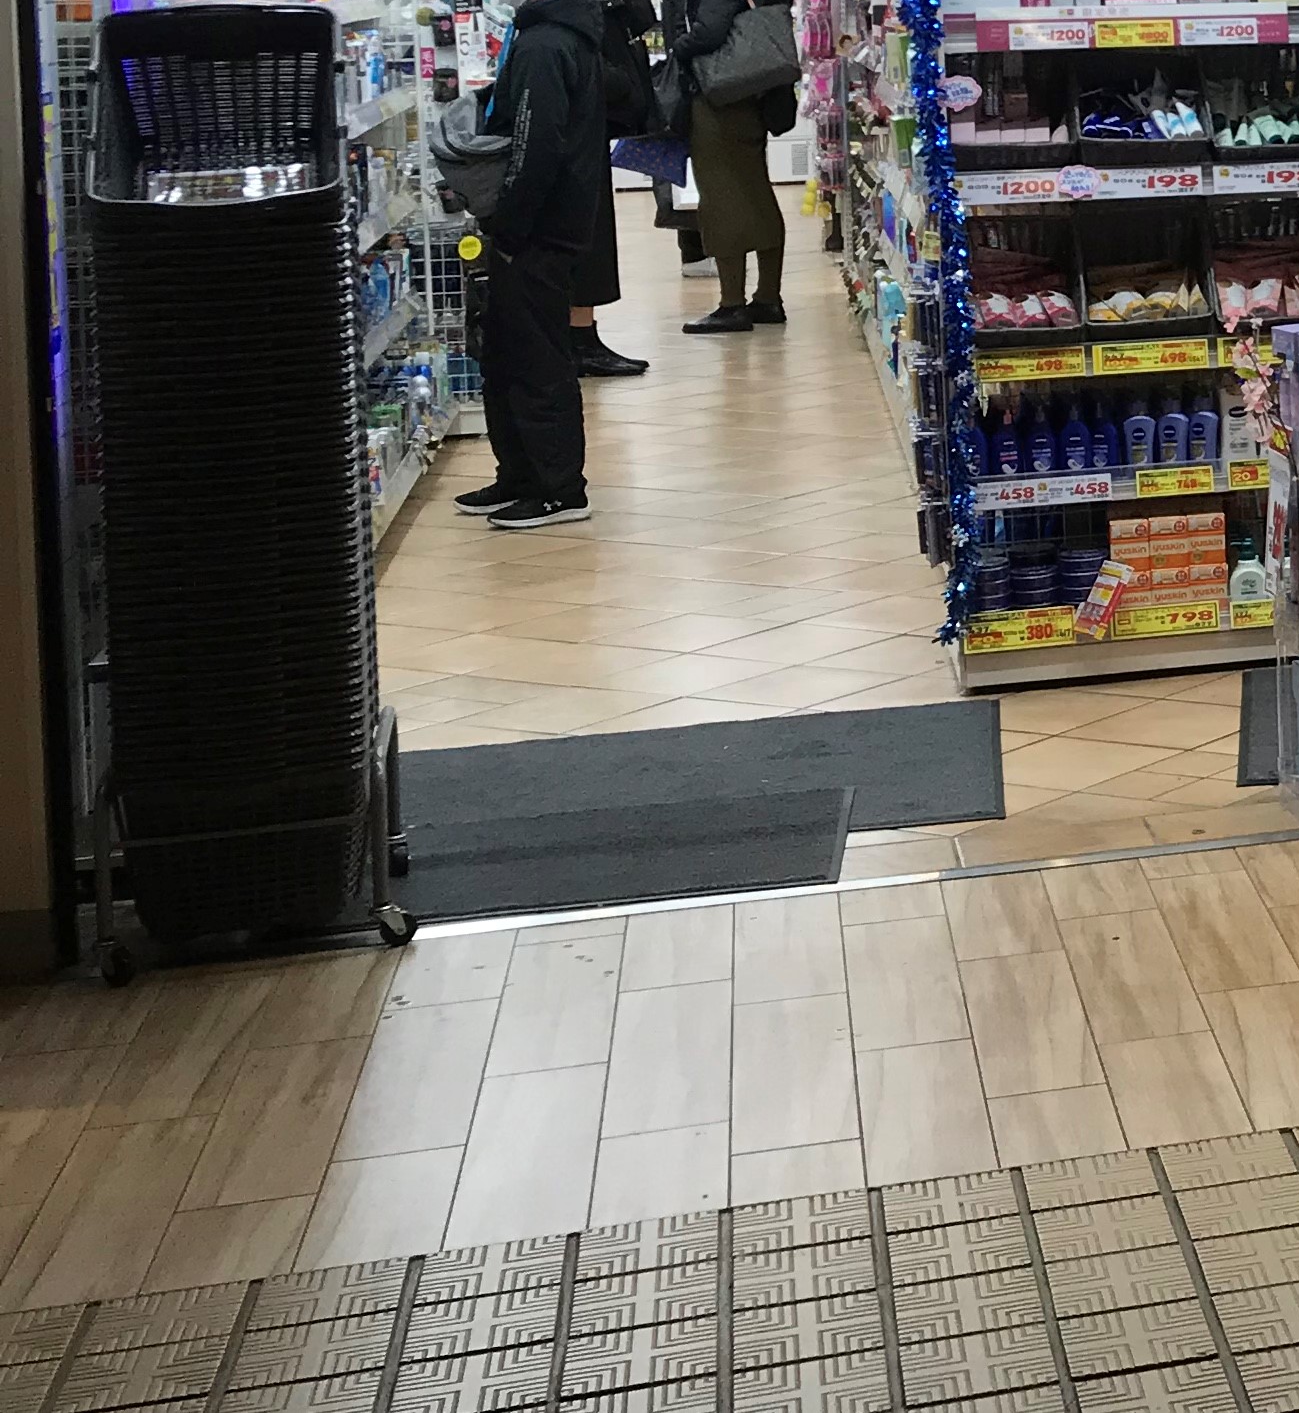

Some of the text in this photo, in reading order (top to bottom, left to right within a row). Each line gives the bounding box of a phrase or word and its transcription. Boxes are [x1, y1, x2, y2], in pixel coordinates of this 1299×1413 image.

[1051, 29, 1086, 42] 1200
[1220, 24, 1254, 38] 1200
[1003, 180, 1055, 195] 1200
[1147, 174, 1198, 189] 198
[1160, 352, 1187, 364] 498
[1000, 486, 1035, 500] 458
[1074, 481, 1109, 495] 458
[1153, 541, 1186, 554] yuskin
[1190, 537, 1224, 550] yuskin
[1114, 545, 1147, 557] yuskin
[1117, 592, 1149, 604] uskin
[1154, 589, 1188, 602] yuskin
[1192, 586, 1225, 598] yuskin
[1166, 610, 1214, 625] 798
[1026, 623, 1052, 641] 380
